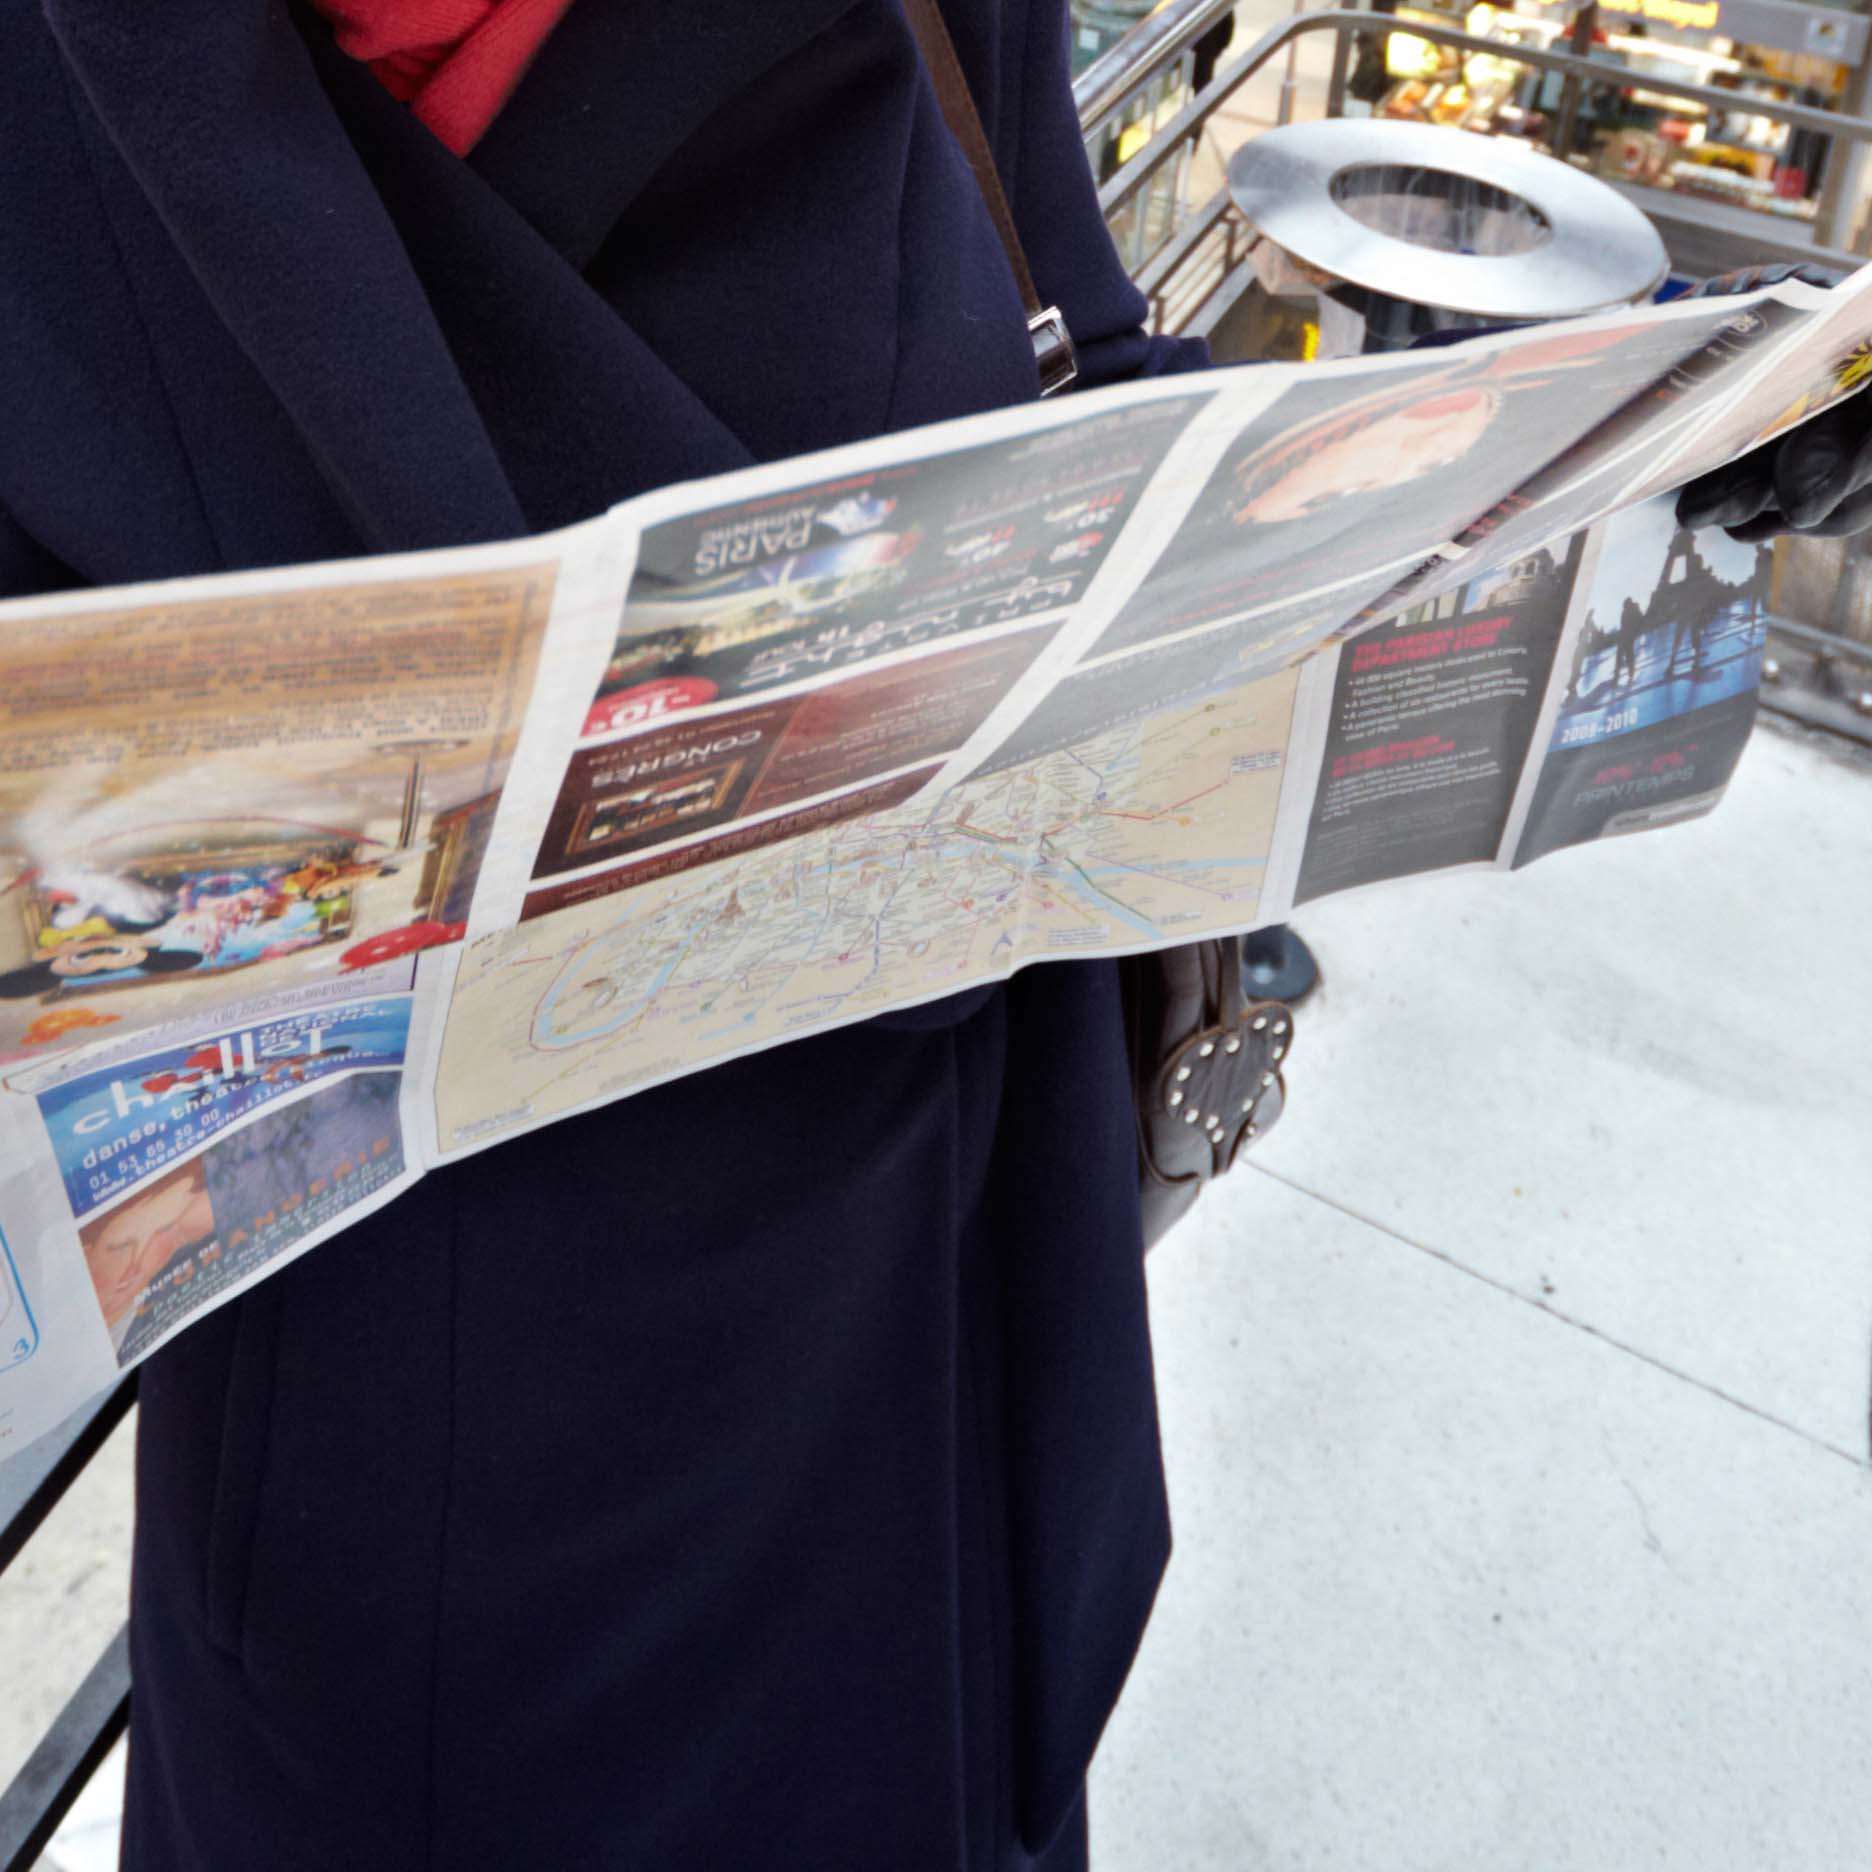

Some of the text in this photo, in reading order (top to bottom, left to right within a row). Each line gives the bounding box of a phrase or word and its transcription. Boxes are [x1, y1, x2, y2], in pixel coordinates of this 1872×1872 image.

[694, 518, 814, 578] PARIS
[590, 730, 763, 790] CONGRÈS
[82, 1121, 167, 1170] danse,
[89, 1167, 111, 1189] 01
[118, 1152, 139, 1176] 53
[200, 1107, 221, 1127] 00
[12, 1336, 32, 1360] 3
